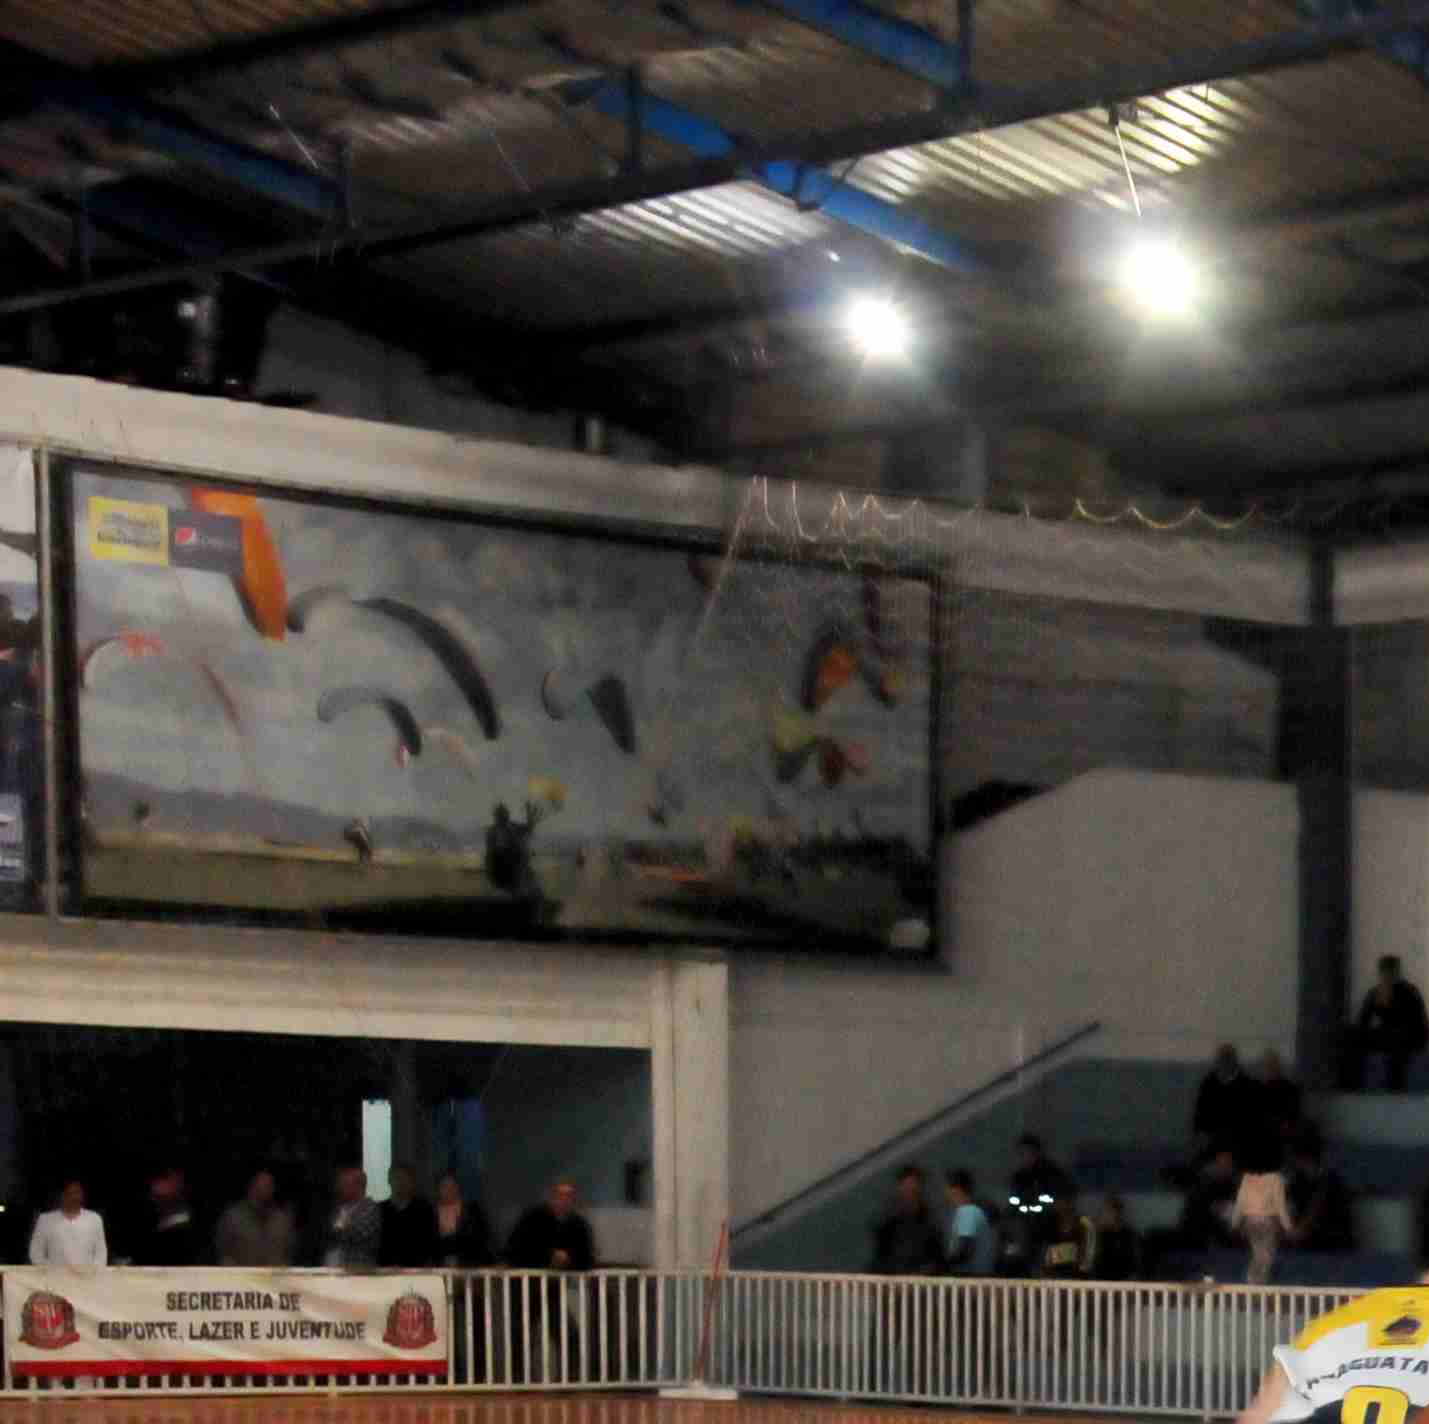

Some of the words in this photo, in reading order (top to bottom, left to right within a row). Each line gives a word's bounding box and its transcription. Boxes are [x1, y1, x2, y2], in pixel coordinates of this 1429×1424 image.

[166, 1291, 274, 1312] SECRETARIA
[278, 1293, 302, 1311] DE
[188, 1321, 244, 1340] LAZER
[250, 1322, 260, 1340] E
[265, 1321, 366, 1340] JUVENTUDE
